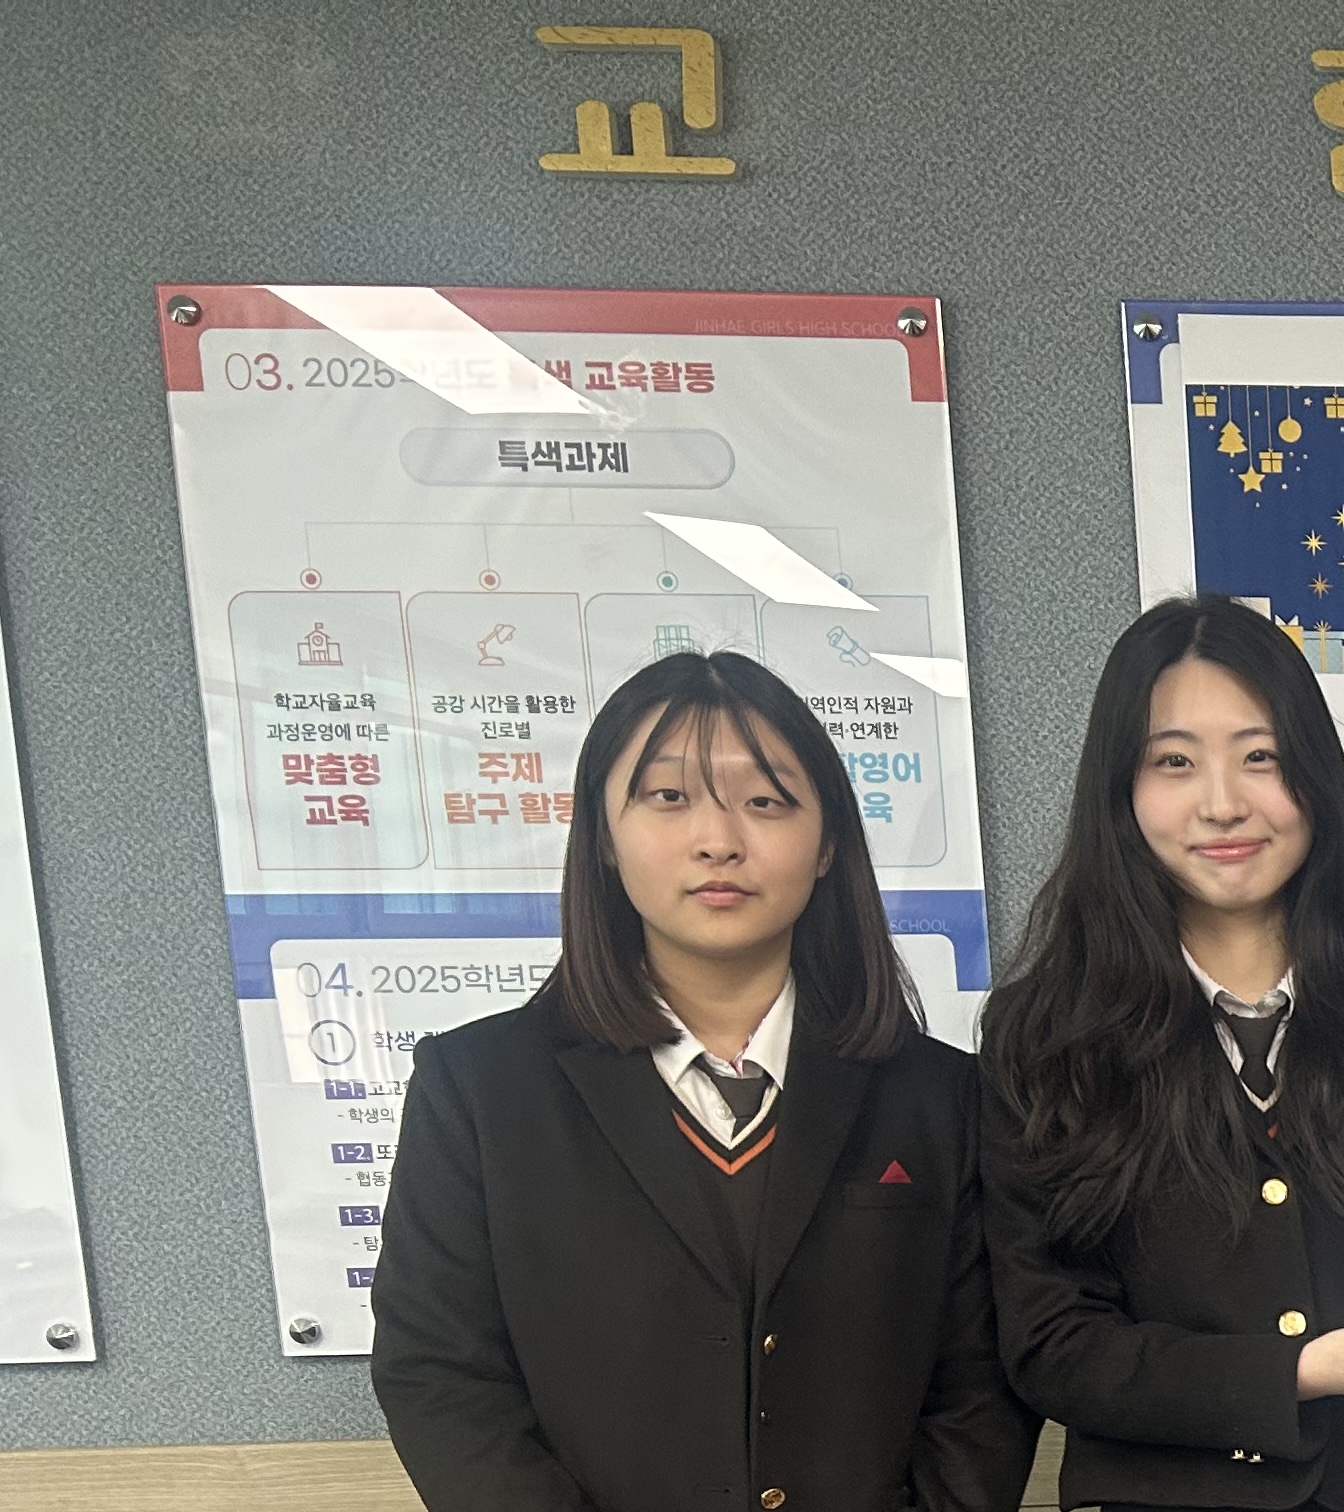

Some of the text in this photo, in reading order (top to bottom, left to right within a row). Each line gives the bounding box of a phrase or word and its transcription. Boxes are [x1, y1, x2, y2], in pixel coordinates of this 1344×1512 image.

[535, 25, 737, 176] 교
[694, 319, 836, 335] JINHAE GIRLS HIGH
[225, 353, 716, 394] 03. 교육활동
[497, 440, 629, 474] 특색과제
[274, 693, 377, 712] 학교자율교육
[431, 695, 576, 714] 공강 시간을 활용한
[864, 696, 913, 714] 자원과
[266, 722, 390, 742] 과정운영에 따른
[481, 721, 531, 740] 진로별
[282, 753, 381, 786] 맞춤형
[478, 752, 543, 784] 주제
[304, 794, 370, 828] 교육
[444, 793, 510, 825] 탐구
[296, 962, 363, 998] 04.
[348, 1107, 396, 1124] 학생의
[335, 1145, 371, 1162] 1-2.
[344, 1208, 379, 1225] 1-3.
